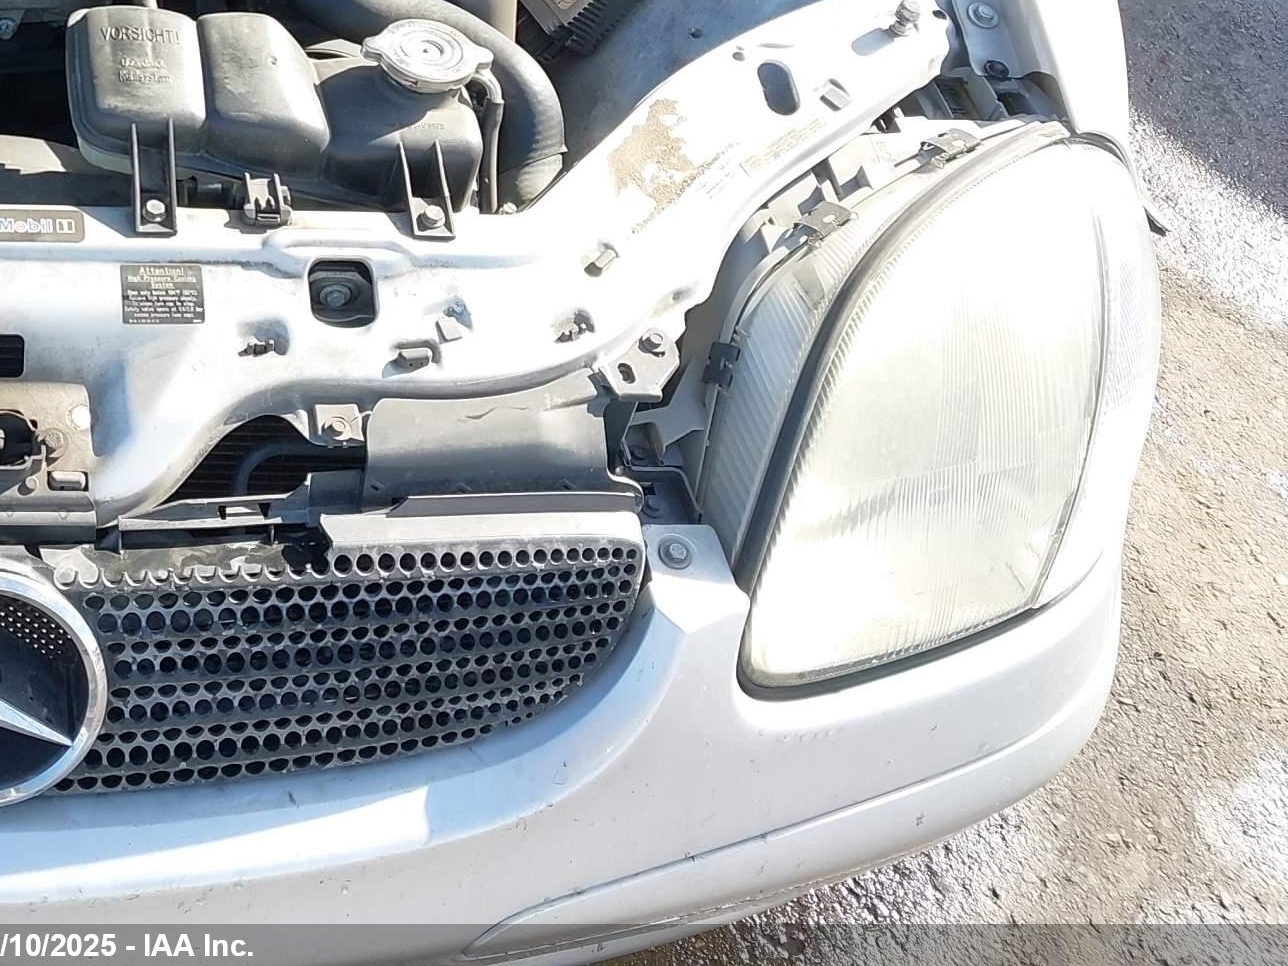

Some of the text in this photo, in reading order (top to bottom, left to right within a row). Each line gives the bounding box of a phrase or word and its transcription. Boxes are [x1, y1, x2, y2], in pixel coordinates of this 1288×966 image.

[100, 26, 180, 45] VORSICHT!
[56, 218, 76, 234] 1
[139, 265, 184, 275] Attention!
